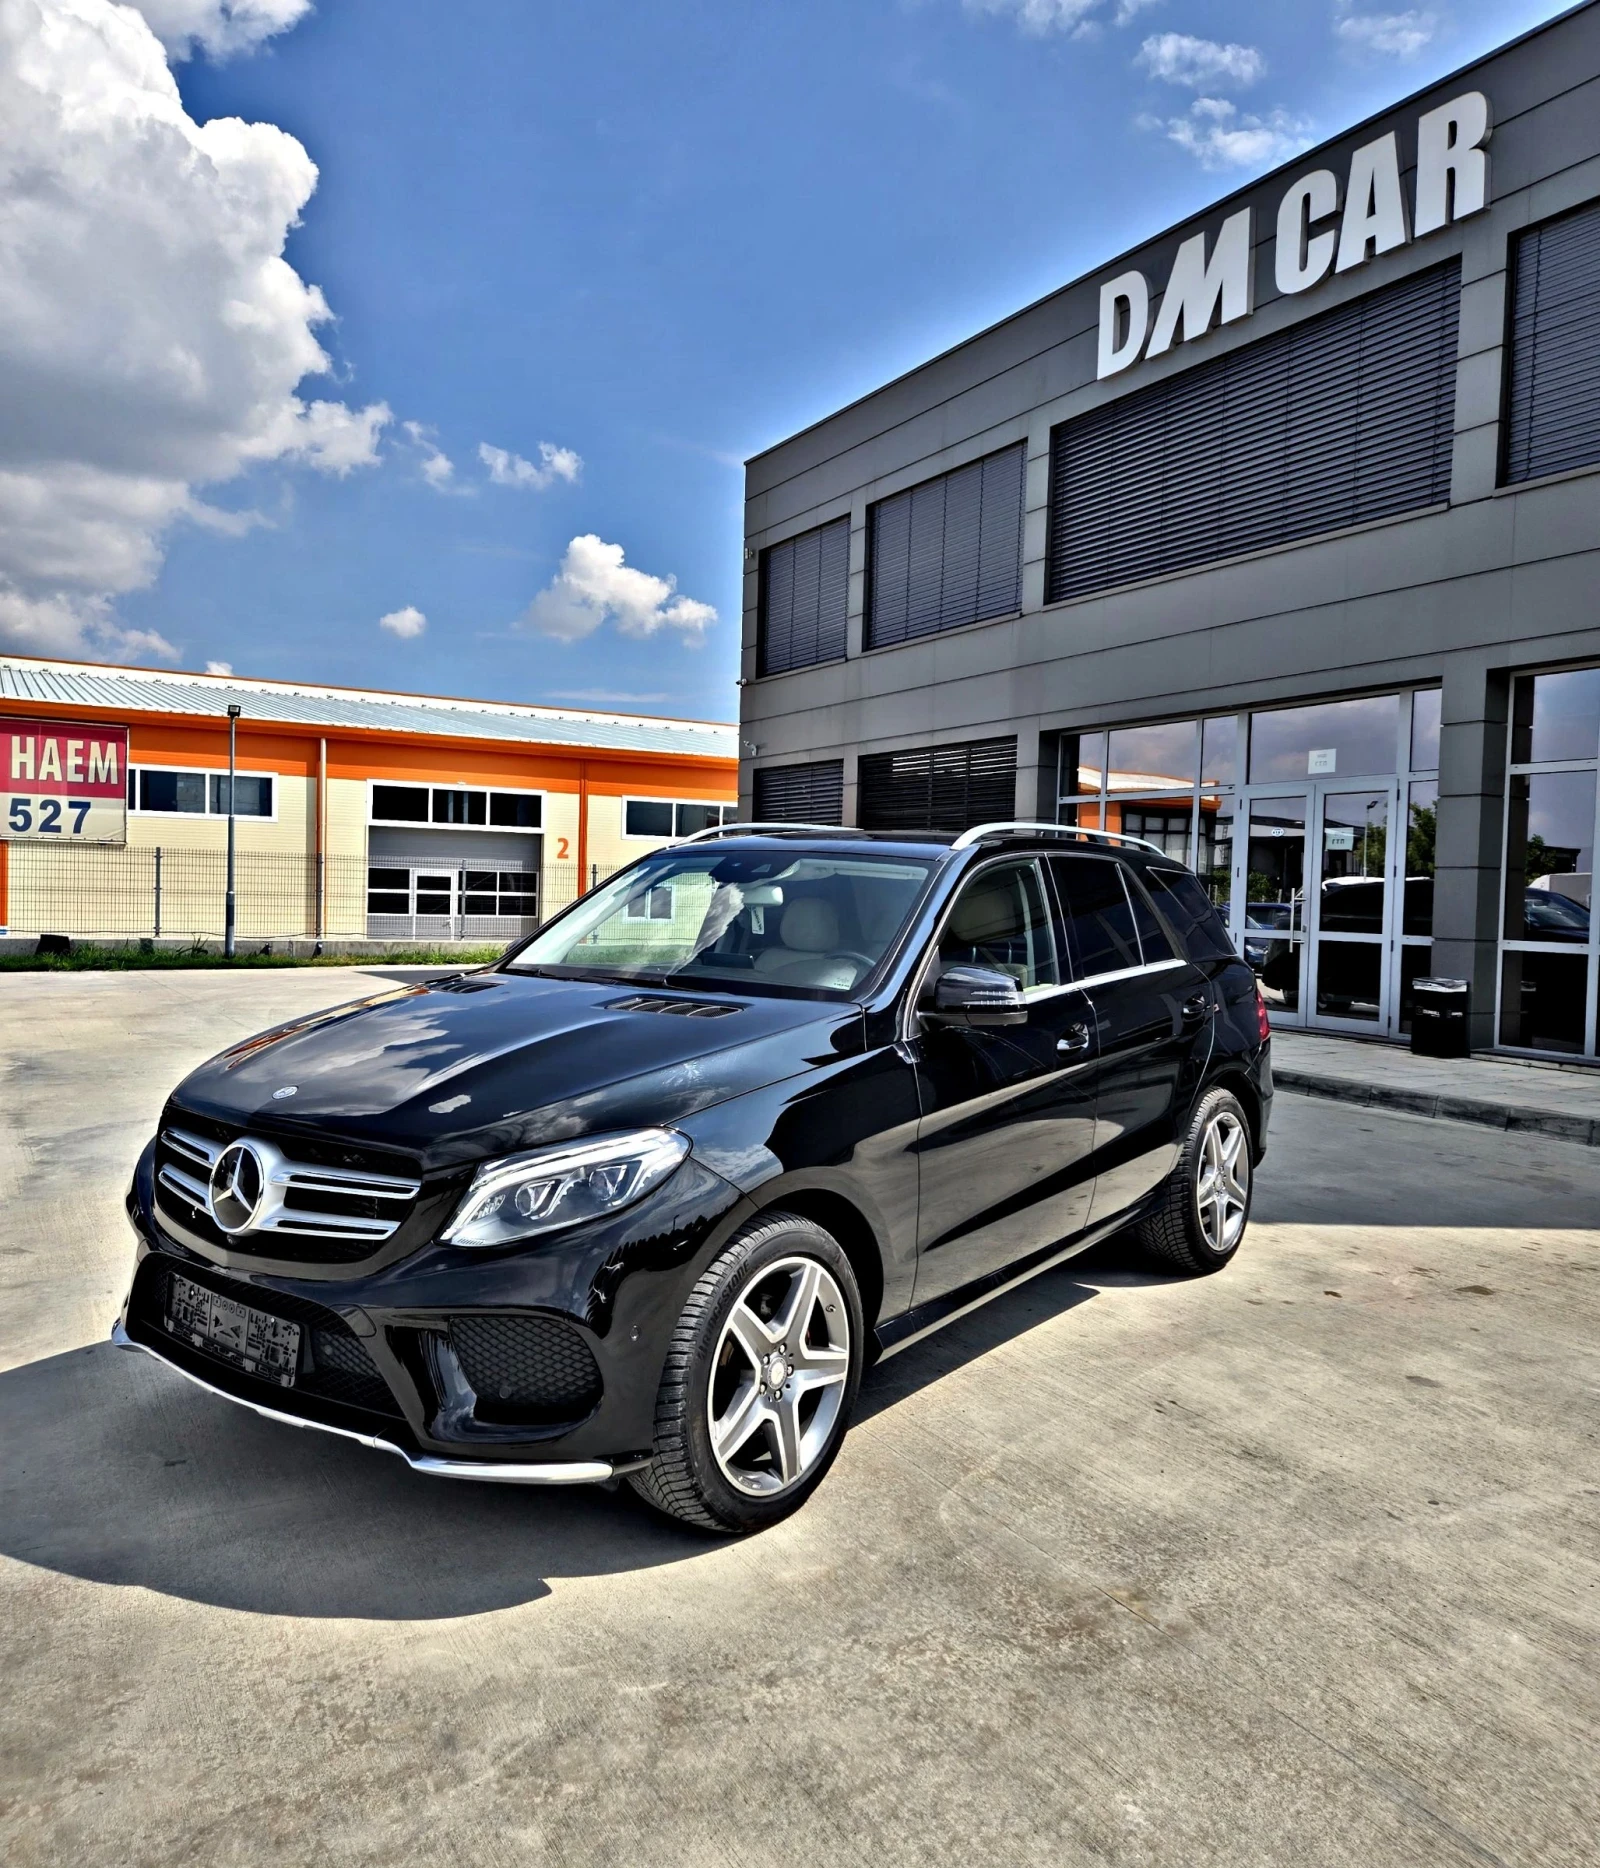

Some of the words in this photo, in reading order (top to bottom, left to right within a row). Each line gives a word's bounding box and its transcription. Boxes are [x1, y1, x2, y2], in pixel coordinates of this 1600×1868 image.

[1097, 206, 1256, 380] DM
[1275, 91, 1493, 294] CAR
[8, 797, 92, 834] 527
[557, 837, 569, 859] 2
